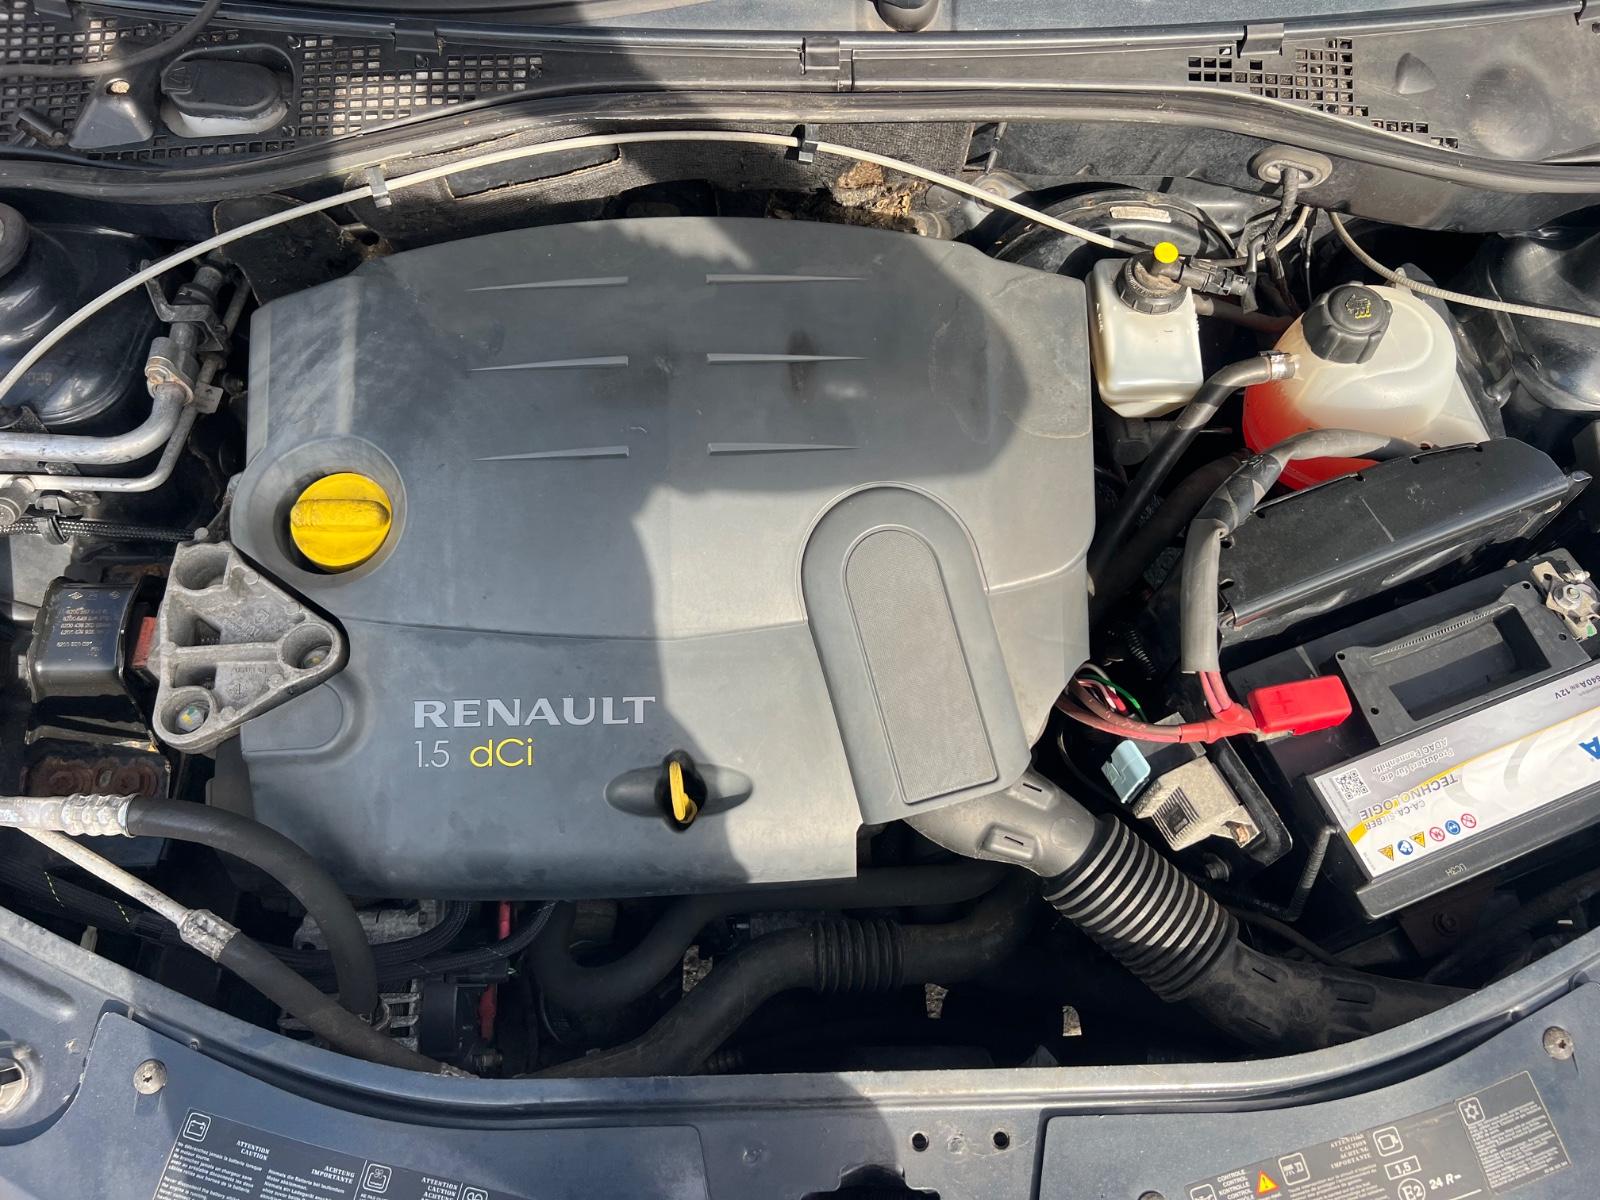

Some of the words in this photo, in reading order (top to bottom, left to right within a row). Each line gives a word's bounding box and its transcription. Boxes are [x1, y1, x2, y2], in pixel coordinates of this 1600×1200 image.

[1554, 687, 1571, 699] 12V
[413, 696, 656, 728] RENAULT
[414, 739, 450, 767] 1.5
[469, 737, 534, 767] dCi
[1422, 738, 1448, 753] ADAC
[1371, 749, 1421, 775] Pannenhilfe
[1409, 748, 1455, 771] Produziert
[1379, 772, 1394, 783] die
[1359, 773, 1458, 821] TECHNOLOGIE
[236, 1139, 270, 1155] ATTENTION
[1330, 1133, 1365, 1149] ATTENTION
[1339, 1140, 1367, 1152] CAUTION
[240, 1148, 269, 1161] CAUTION
[324, 1165, 355, 1178] ACHTUNG
[1394, 1161, 1411, 1176] 1,5
[311, 1168, 354, 1185] IMPORTANTE
[421, 1176, 459, 1190] ATTENTION
[1428, 1176, 1443, 1190] 24
[427, 1185, 457, 1197] CAUTION
[1401, 1185, 1423, 1200] E2
